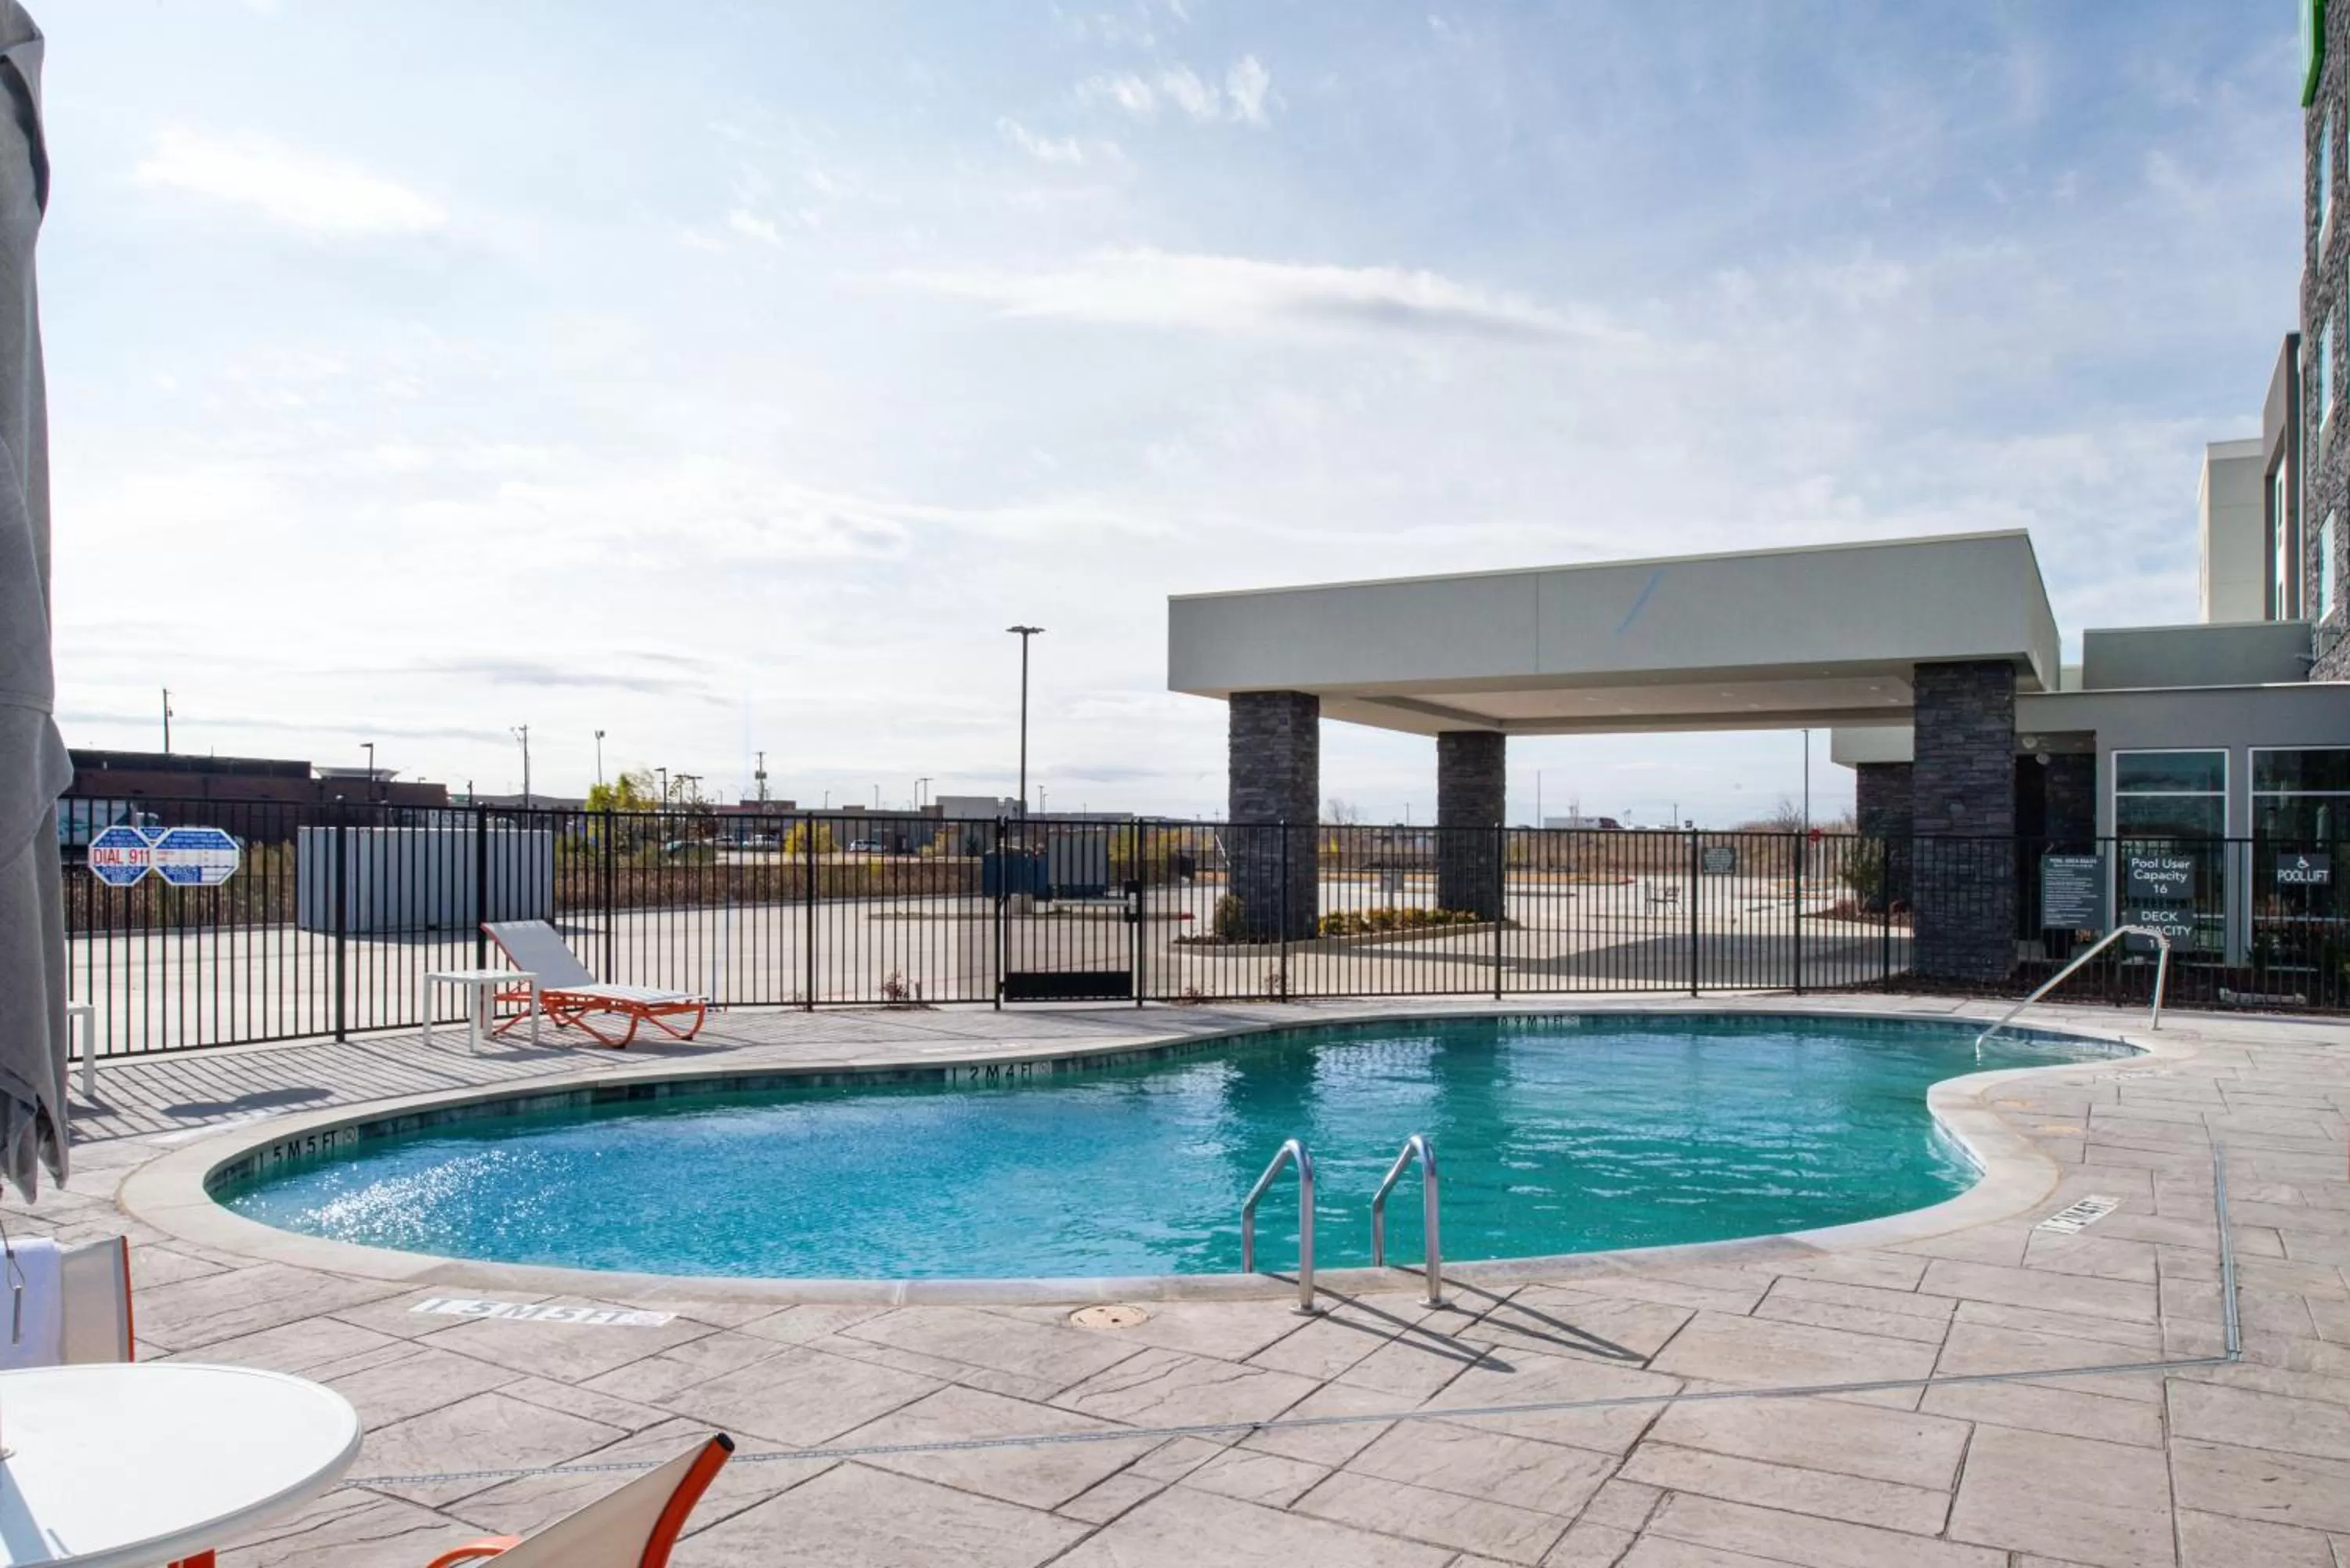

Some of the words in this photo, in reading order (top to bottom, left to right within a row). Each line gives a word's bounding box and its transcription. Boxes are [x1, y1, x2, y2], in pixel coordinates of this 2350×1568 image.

[94, 848, 123, 865] DIAL
[129, 848, 151, 865] 911
[2131, 858, 2158, 869] Pool
[2162, 858, 2190, 869] User
[2133, 869, 2188, 883] Capacity
[2277, 870, 2306, 882] POOL
[2307, 870, 2329, 882] LIFT
[2153, 883, 2168, 894] 16
[2141, 911, 2178, 921] DECK
